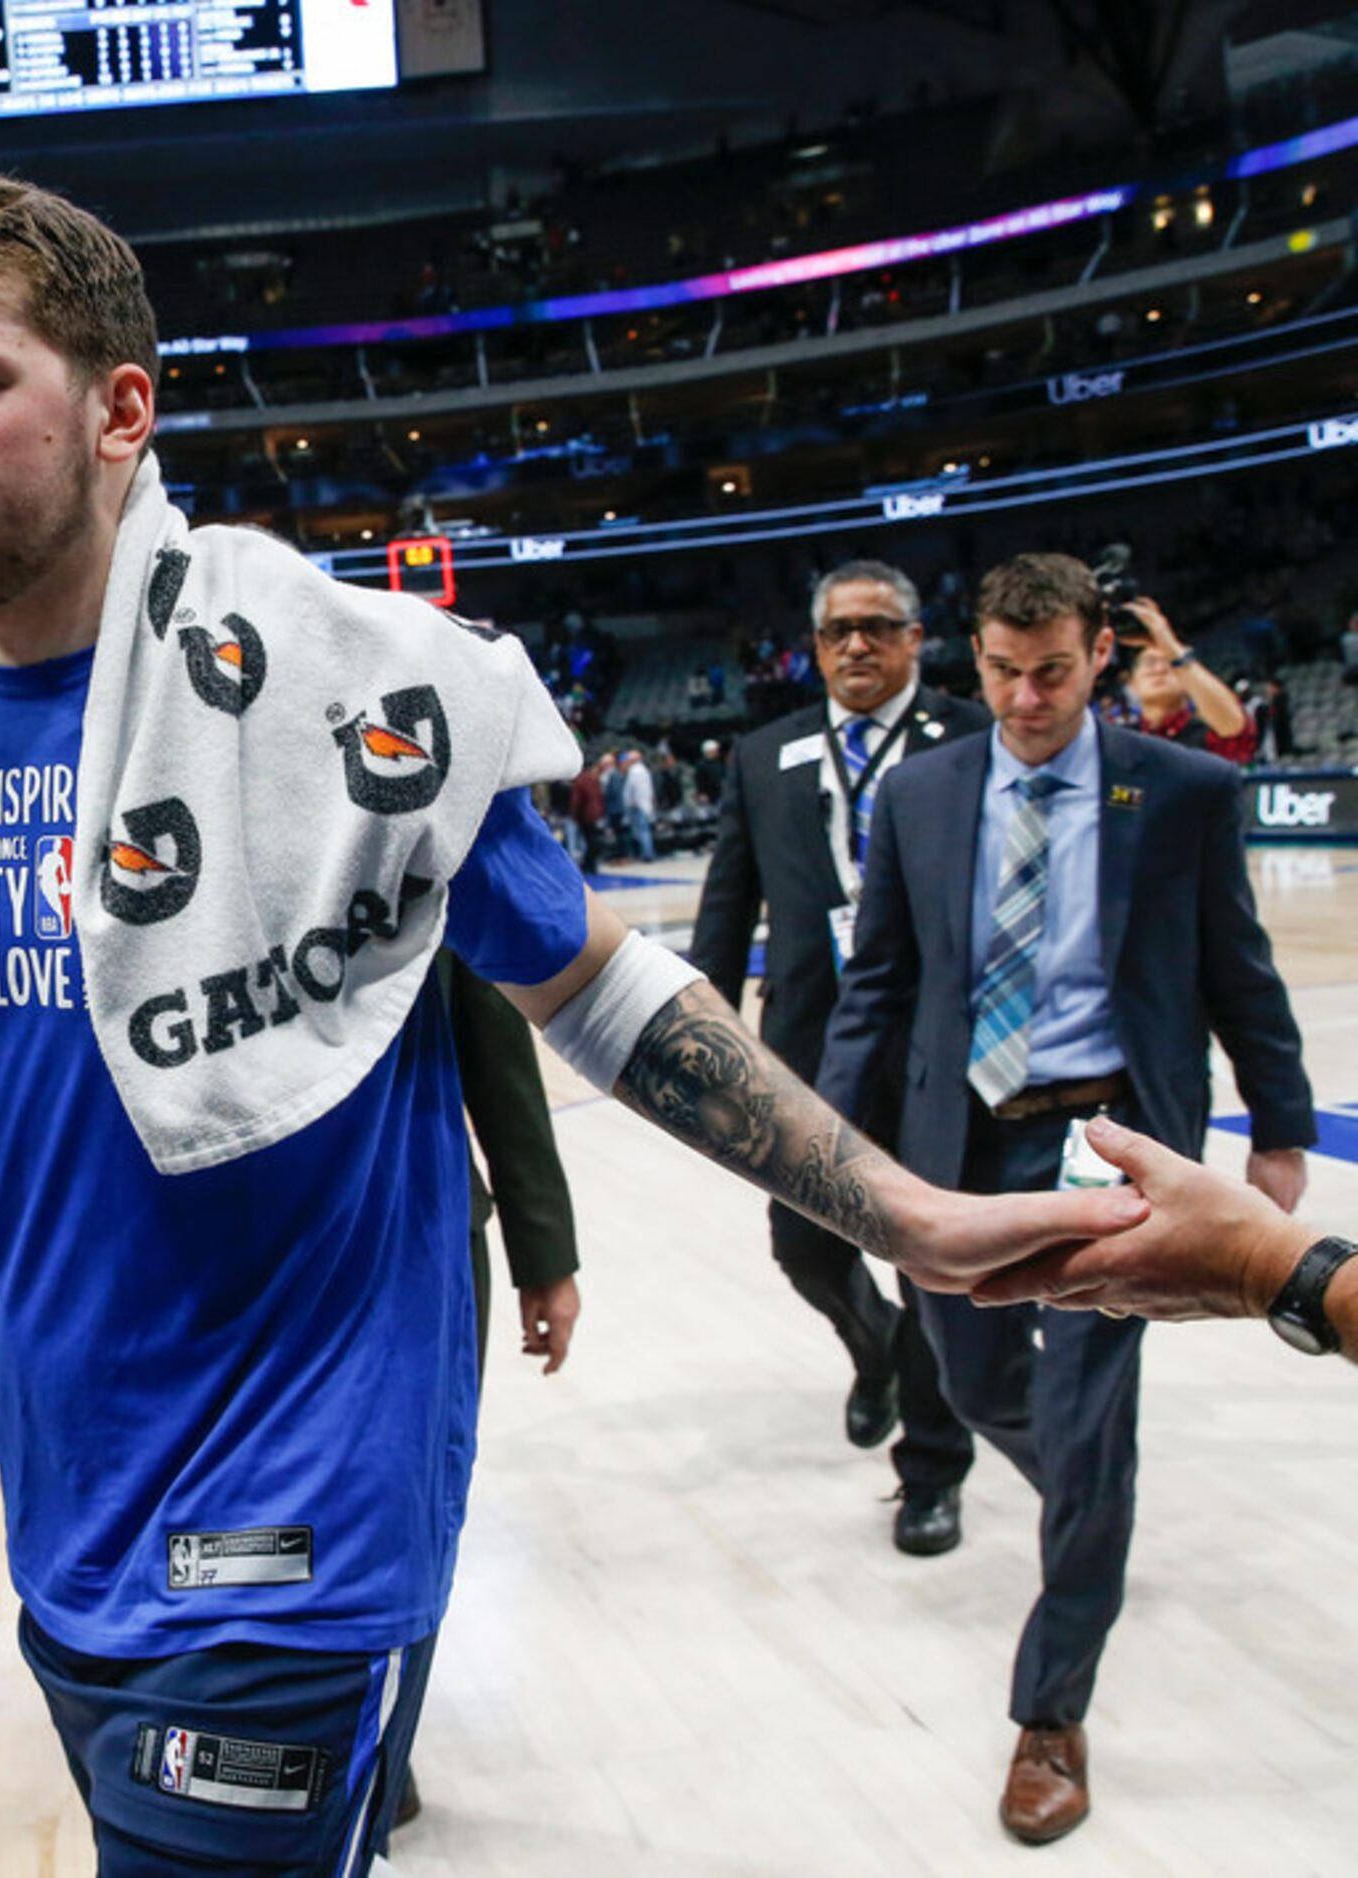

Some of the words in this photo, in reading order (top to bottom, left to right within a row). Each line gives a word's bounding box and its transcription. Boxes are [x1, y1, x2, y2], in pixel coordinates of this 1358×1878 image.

[1046, 371, 1124, 406] Uber
[883, 493, 944, 520] Uber
[510, 538, 566, 562] Uber
[1258, 783, 1337, 827] Uber
